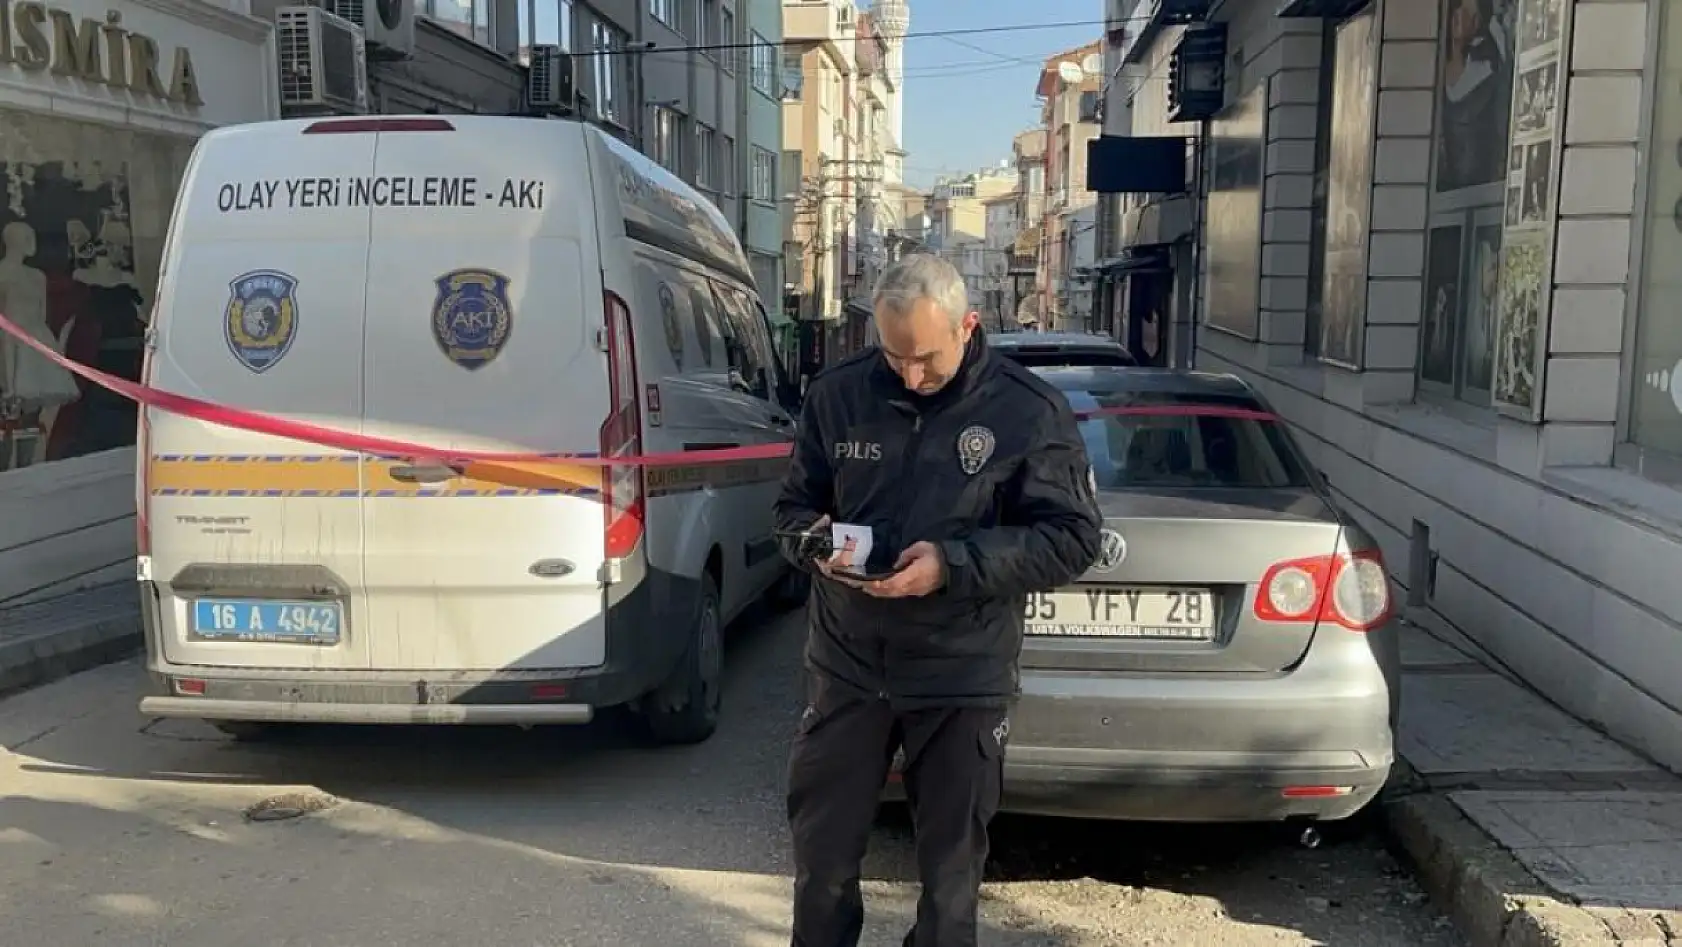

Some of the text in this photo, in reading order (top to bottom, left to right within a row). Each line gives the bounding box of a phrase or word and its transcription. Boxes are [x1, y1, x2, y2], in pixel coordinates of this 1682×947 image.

[217, 180, 279, 212] OLAY
[212, 604, 337, 634] 16 A 4942
[1085, 587, 1142, 622] YFY
[1166, 590, 1202, 624] 28
